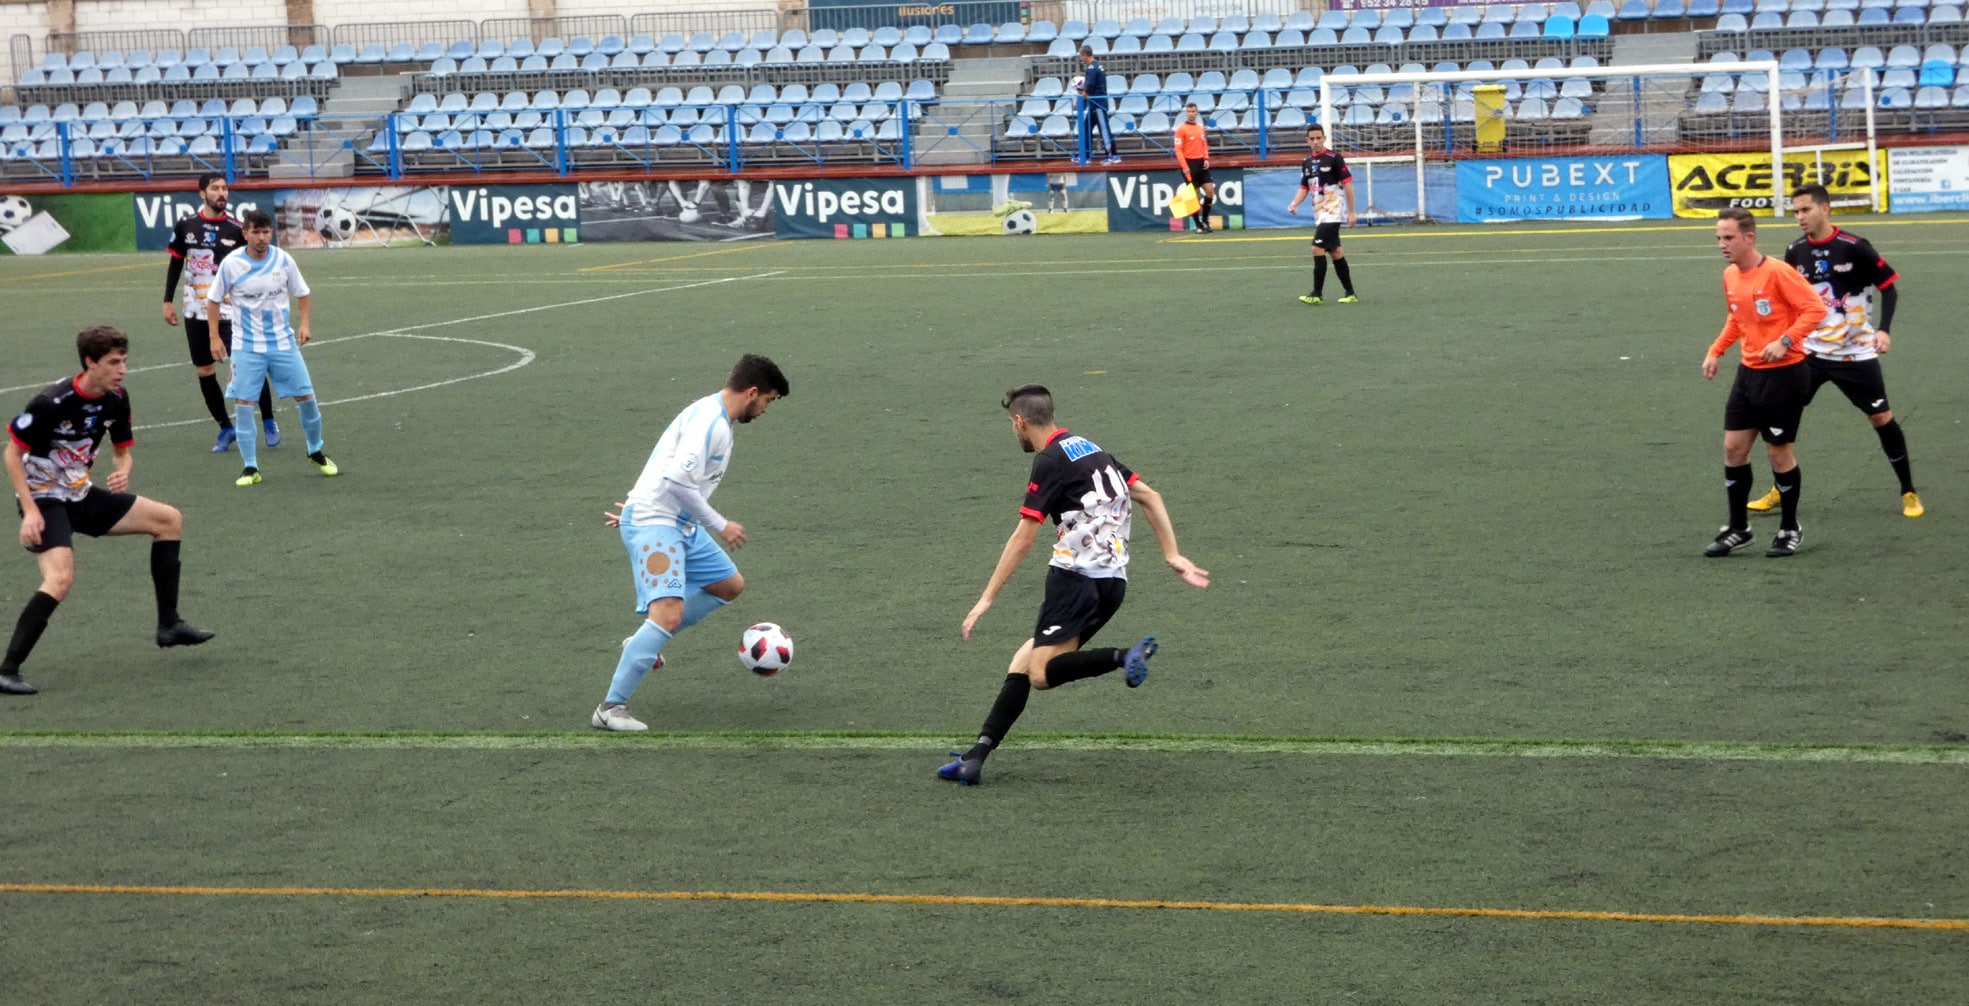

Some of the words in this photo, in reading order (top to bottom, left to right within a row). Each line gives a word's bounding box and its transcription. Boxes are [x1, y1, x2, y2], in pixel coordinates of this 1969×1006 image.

[1485, 161, 1641, 189] PUBEXT
[451, 188, 577, 228] Vipesa
[775, 182, 905, 223] Vipesa
[1475, 203, 1652, 216] #SOMOSPUBLICIDAD
[1504, 194, 1545, 203] PRINT
[1553, 194, 1561, 202] &
[1569, 192, 1621, 201] DESIGN
